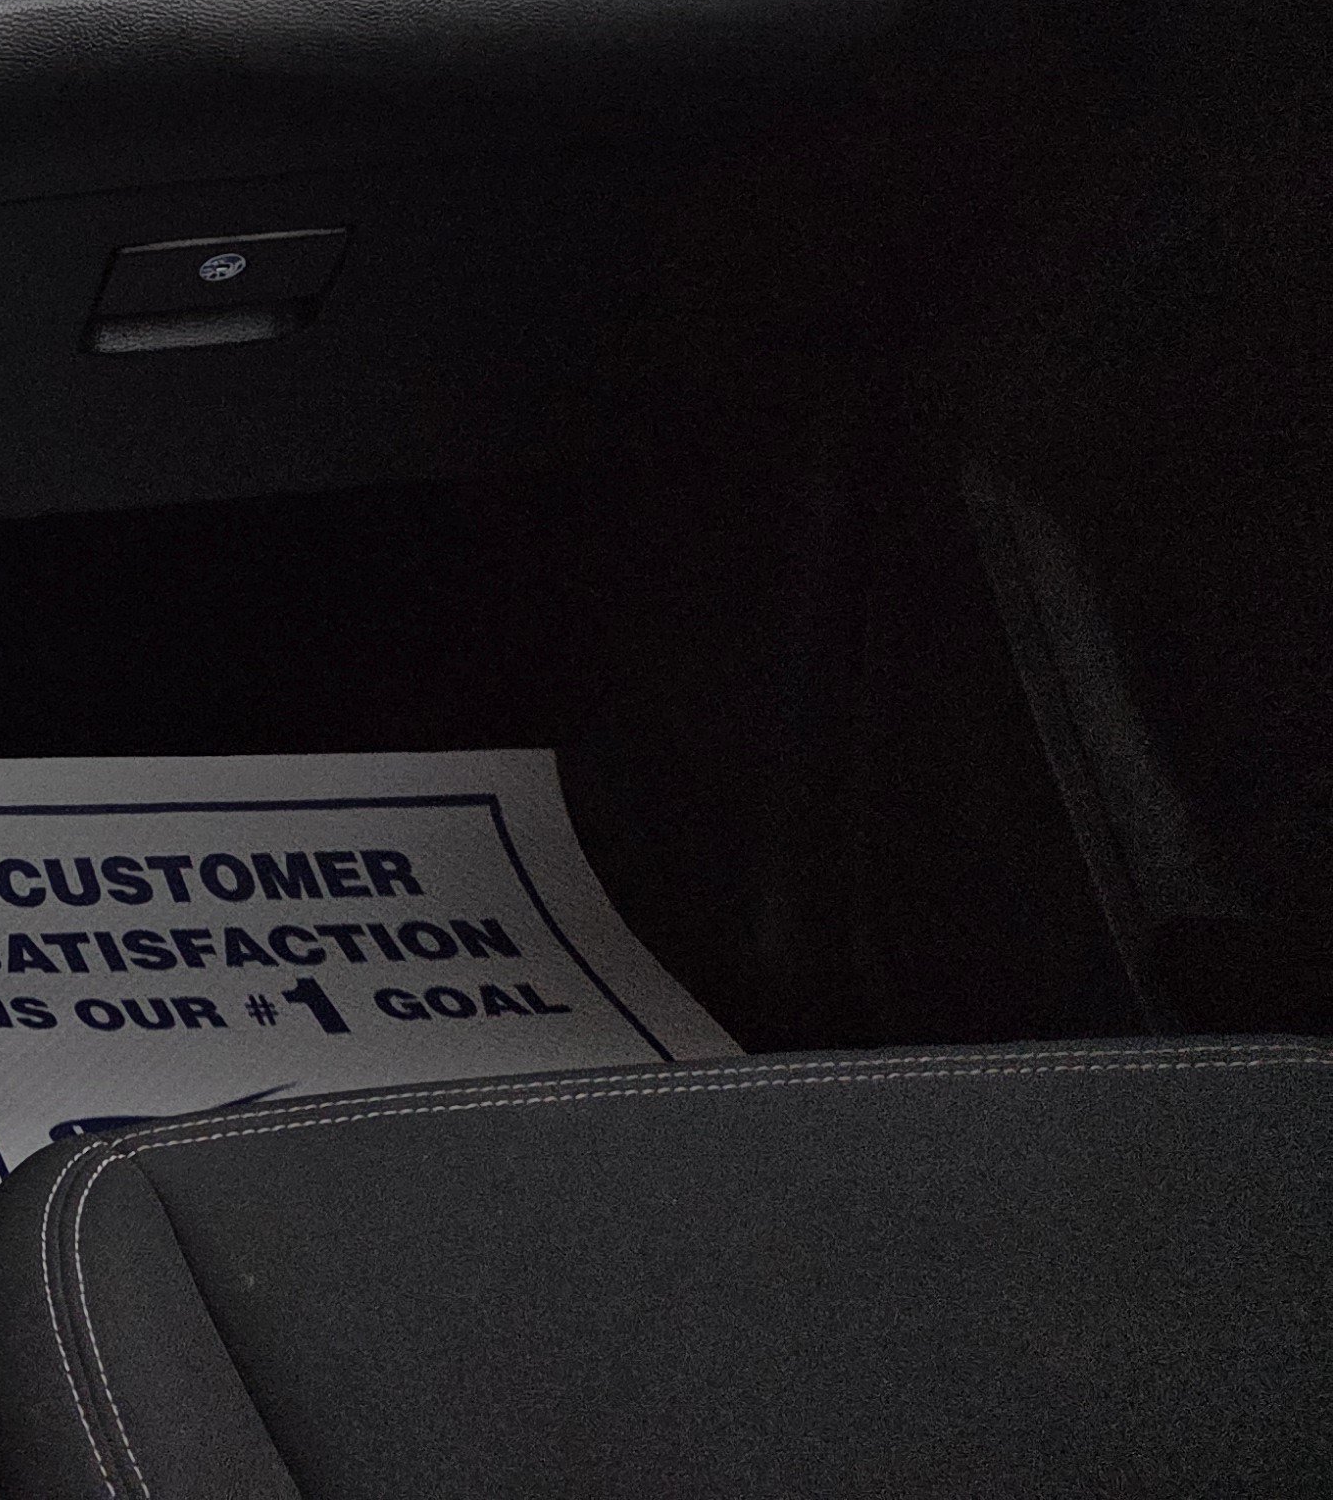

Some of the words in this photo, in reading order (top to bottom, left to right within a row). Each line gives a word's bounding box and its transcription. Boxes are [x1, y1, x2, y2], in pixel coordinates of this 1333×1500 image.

[74, 995, 229, 1032] OUR
[246, 976, 351, 1036] #1
[373, 982, 573, 1024] GOAL
